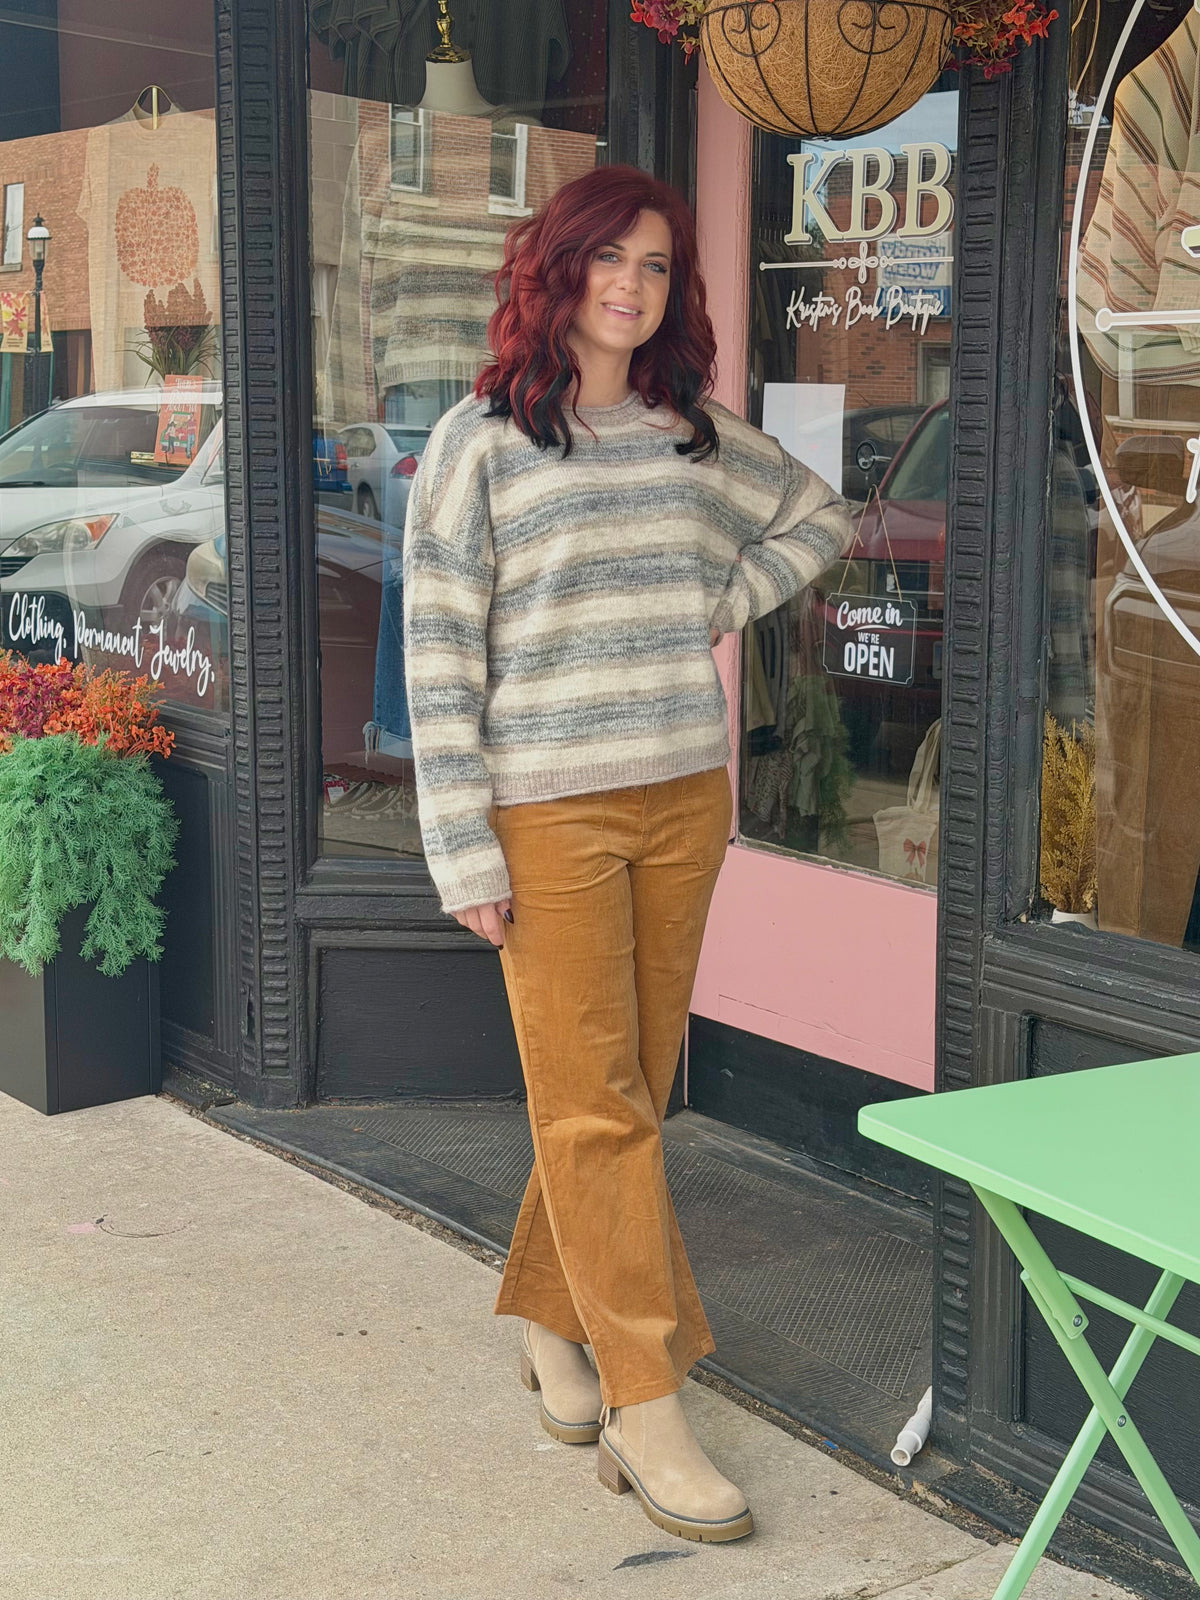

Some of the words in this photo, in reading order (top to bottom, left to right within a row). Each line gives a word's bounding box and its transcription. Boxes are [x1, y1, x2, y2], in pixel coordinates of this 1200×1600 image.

[784, 141, 954, 245] KBB
[885, 285, 944, 335] Boutique
[836, 601, 884, 630] Come
[885, 602, 903, 626] in
[8, 591, 67, 665] Clothing,
[73, 609, 144, 668] Permanent
[149, 617, 215, 697] Jewelry,
[858, 632, 880, 644] WE'RE
[844, 642, 895, 679] OPEN
